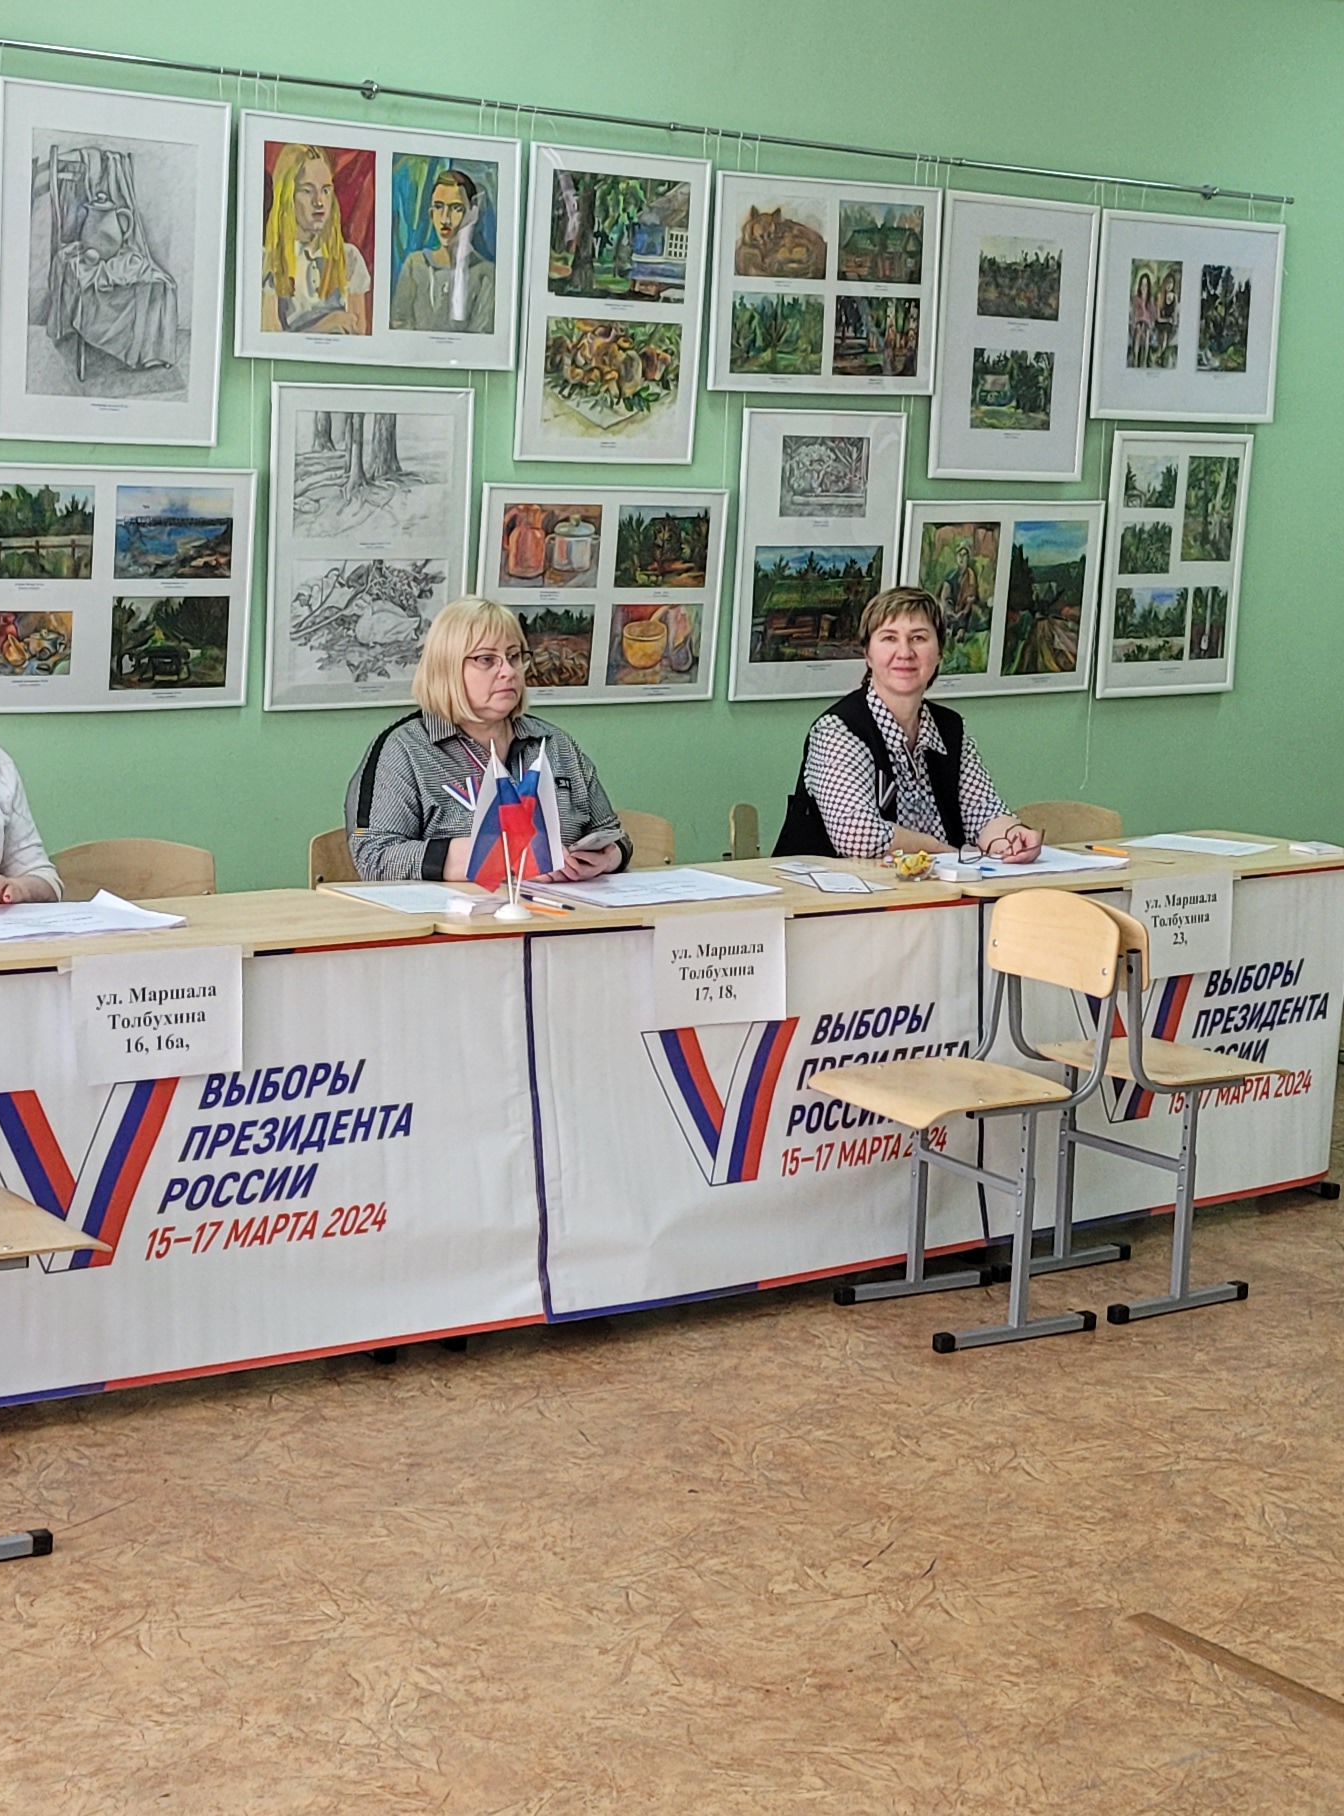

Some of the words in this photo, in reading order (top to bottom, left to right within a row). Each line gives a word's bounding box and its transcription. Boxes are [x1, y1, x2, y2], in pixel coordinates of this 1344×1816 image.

[1144, 898, 1161, 912] ул.
[1164, 891, 1218, 909] Маршала
[1151, 912, 1210, 929] Толбухина
[1172, 931, 1188, 946] 23,
[670, 949, 692, 964] ул.
[696, 942, 764, 960] Маршала
[679, 965, 755, 982] Толбухина
[1204, 958, 1305, 998] ВЫБОРЫ
[96, 993, 123, 1010] ул.
[128, 984, 217, 1006] Маршала
[695, 986, 713, 1002] 17,
[718, 984, 737, 1000] 18,
[107, 1010, 206, 1031] Толбухина
[810, 1002, 935, 1045] ВЫБОРЫ
[1192, 992, 1330, 1039] ПРЕЗИДЕНТА
[125, 1036, 150, 1054] 16,
[155, 1033, 190, 1051] 16а,
[198, 1059, 366, 1110] ВЫБОРЫ
[1273, 1069, 1312, 1099] 2024
[178, 1102, 414, 1163] ПРЕЗИДЕНТА
[837, 1132, 902, 1169] МАРТА
[157, 1163, 319, 1214] РОССИИ
[222, 1213, 322, 1252] МАРТА
[320, 1201, 388, 1239] 2024
